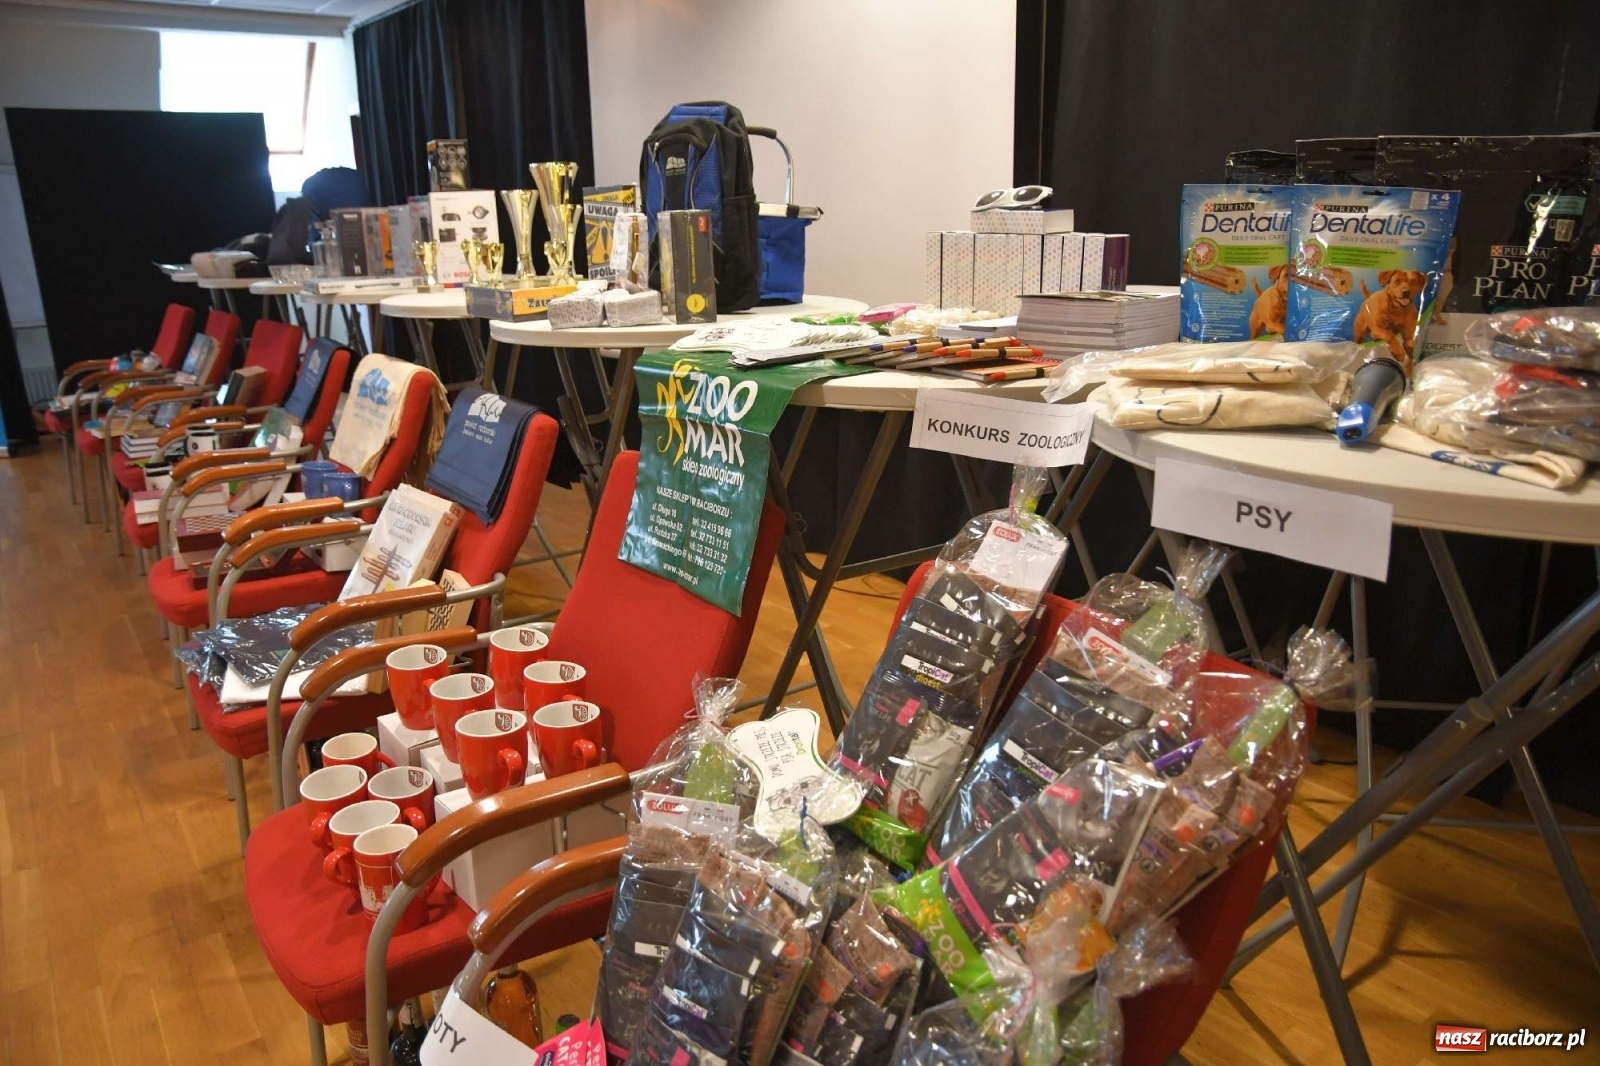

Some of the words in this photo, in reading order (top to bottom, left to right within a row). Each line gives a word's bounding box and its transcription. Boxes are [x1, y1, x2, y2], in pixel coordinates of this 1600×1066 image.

[1215, 203, 1253, 212] PURINA
[1441, 193, 1450, 201] 4
[1324, 205, 1367, 213] PURINA
[1504, 247, 1547, 258] PURNA
[1489, 257, 1546, 280] PRO
[1472, 277, 1554, 300] PLAN
[687, 373, 758, 421] ZOO
[684, 415, 745, 467] MAR
[927, 418, 1010, 444] KONKURS
[1017, 430, 1085, 449] ZOOLOGICZNY
[698, 460, 745, 491] zoologiczny
[673, 491, 691, 504] SKLEP
[696, 499, 730, 517] RACIBORZU
[1236, 500, 1293, 532] PSY
[720, 553, 728, 564] 32
[917, 660, 950, 683] TropiCat
[1020, 751, 1054, 779] TropiCat
